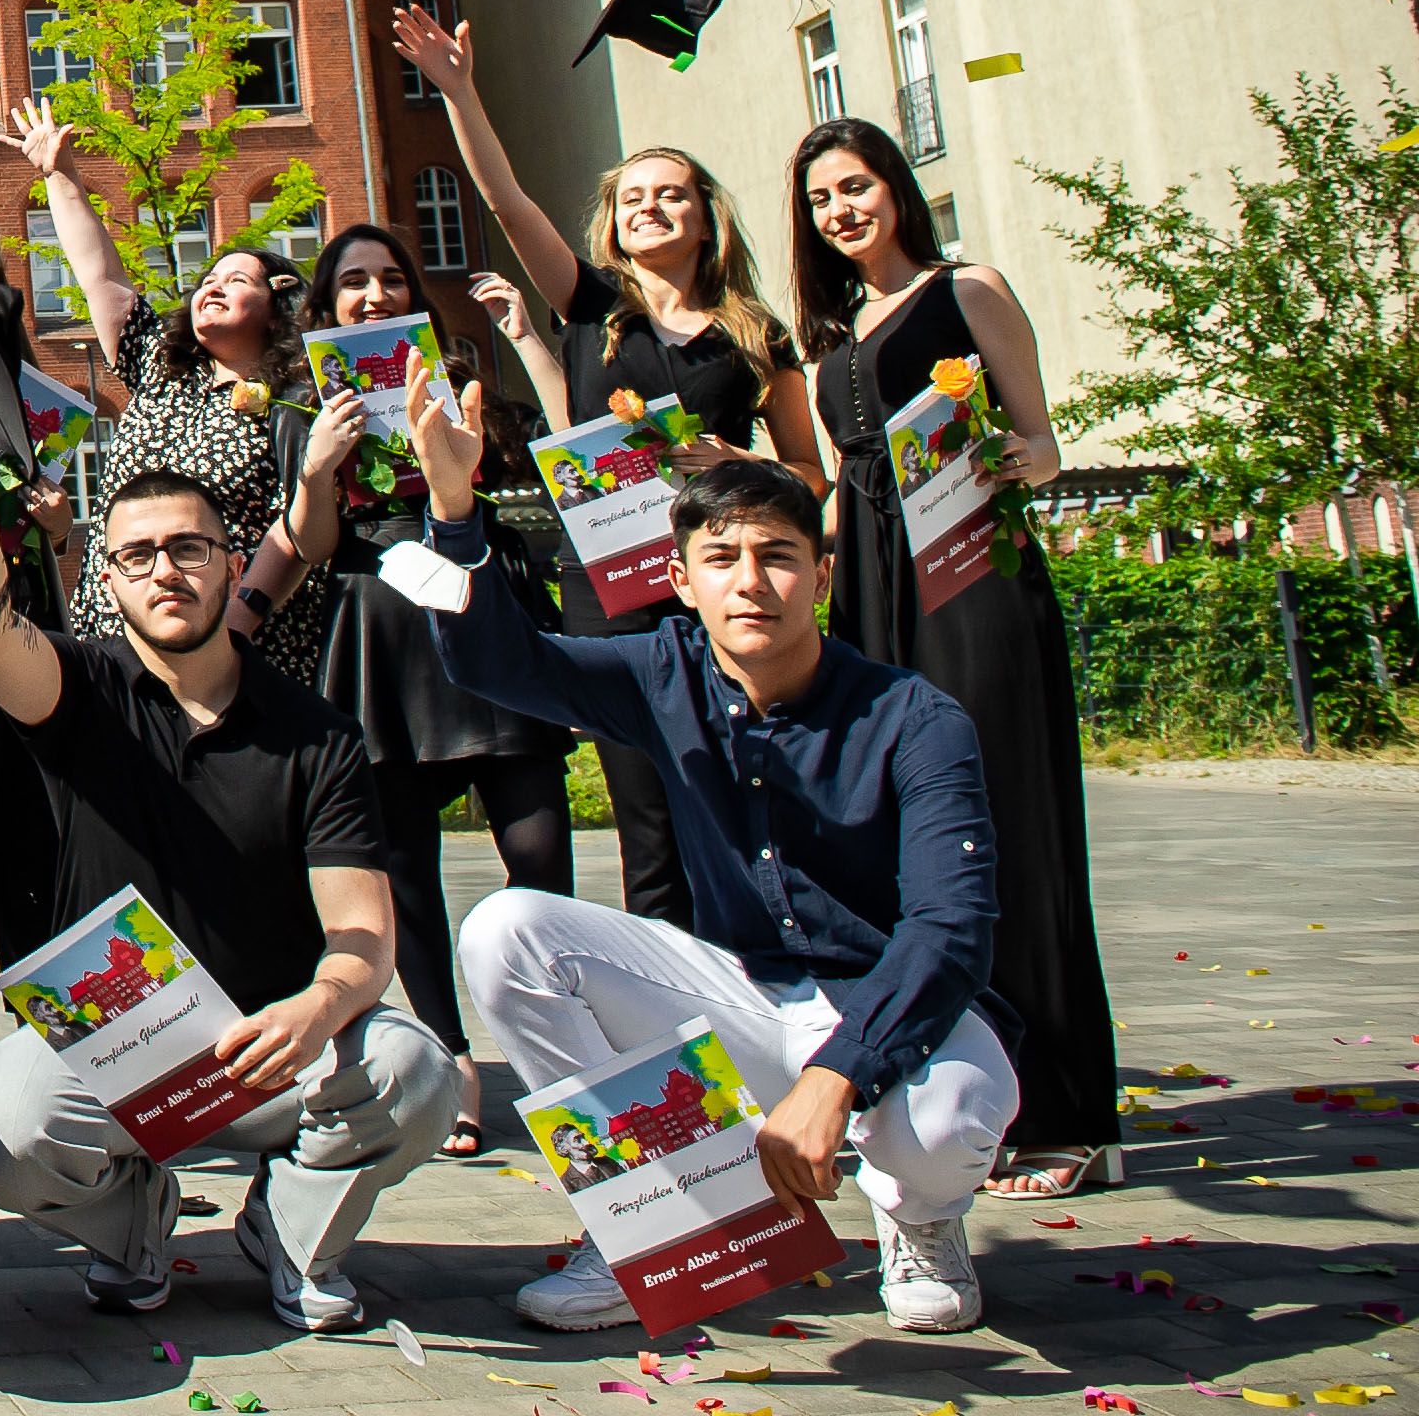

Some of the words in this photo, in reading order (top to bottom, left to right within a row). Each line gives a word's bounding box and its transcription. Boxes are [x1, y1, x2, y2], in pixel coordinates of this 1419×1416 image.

[606, 566, 633, 582] Ernst
[640, 556, 665, 571] Abbe
[90, 1039, 138, 1069] Herzlichen
[139, 992, 202, 1046] Glückwunsch!
[135, 1104, 163, 1125] Ernst
[167, 1088, 193, 1108] Abbe
[184, 1106, 211, 1122] Tradition
[608, 1185, 674, 1216] Herzlichen
[677, 1143, 758, 1194] Glückwunsch!
[642, 1267, 679, 1289] Ernst
[687, 1249, 721, 1271] Abbe
[700, 1274, 735, 1292] Tradition
[734, 1267, 750, 1280] seit
[749, 1258, 768, 1272] 1902
